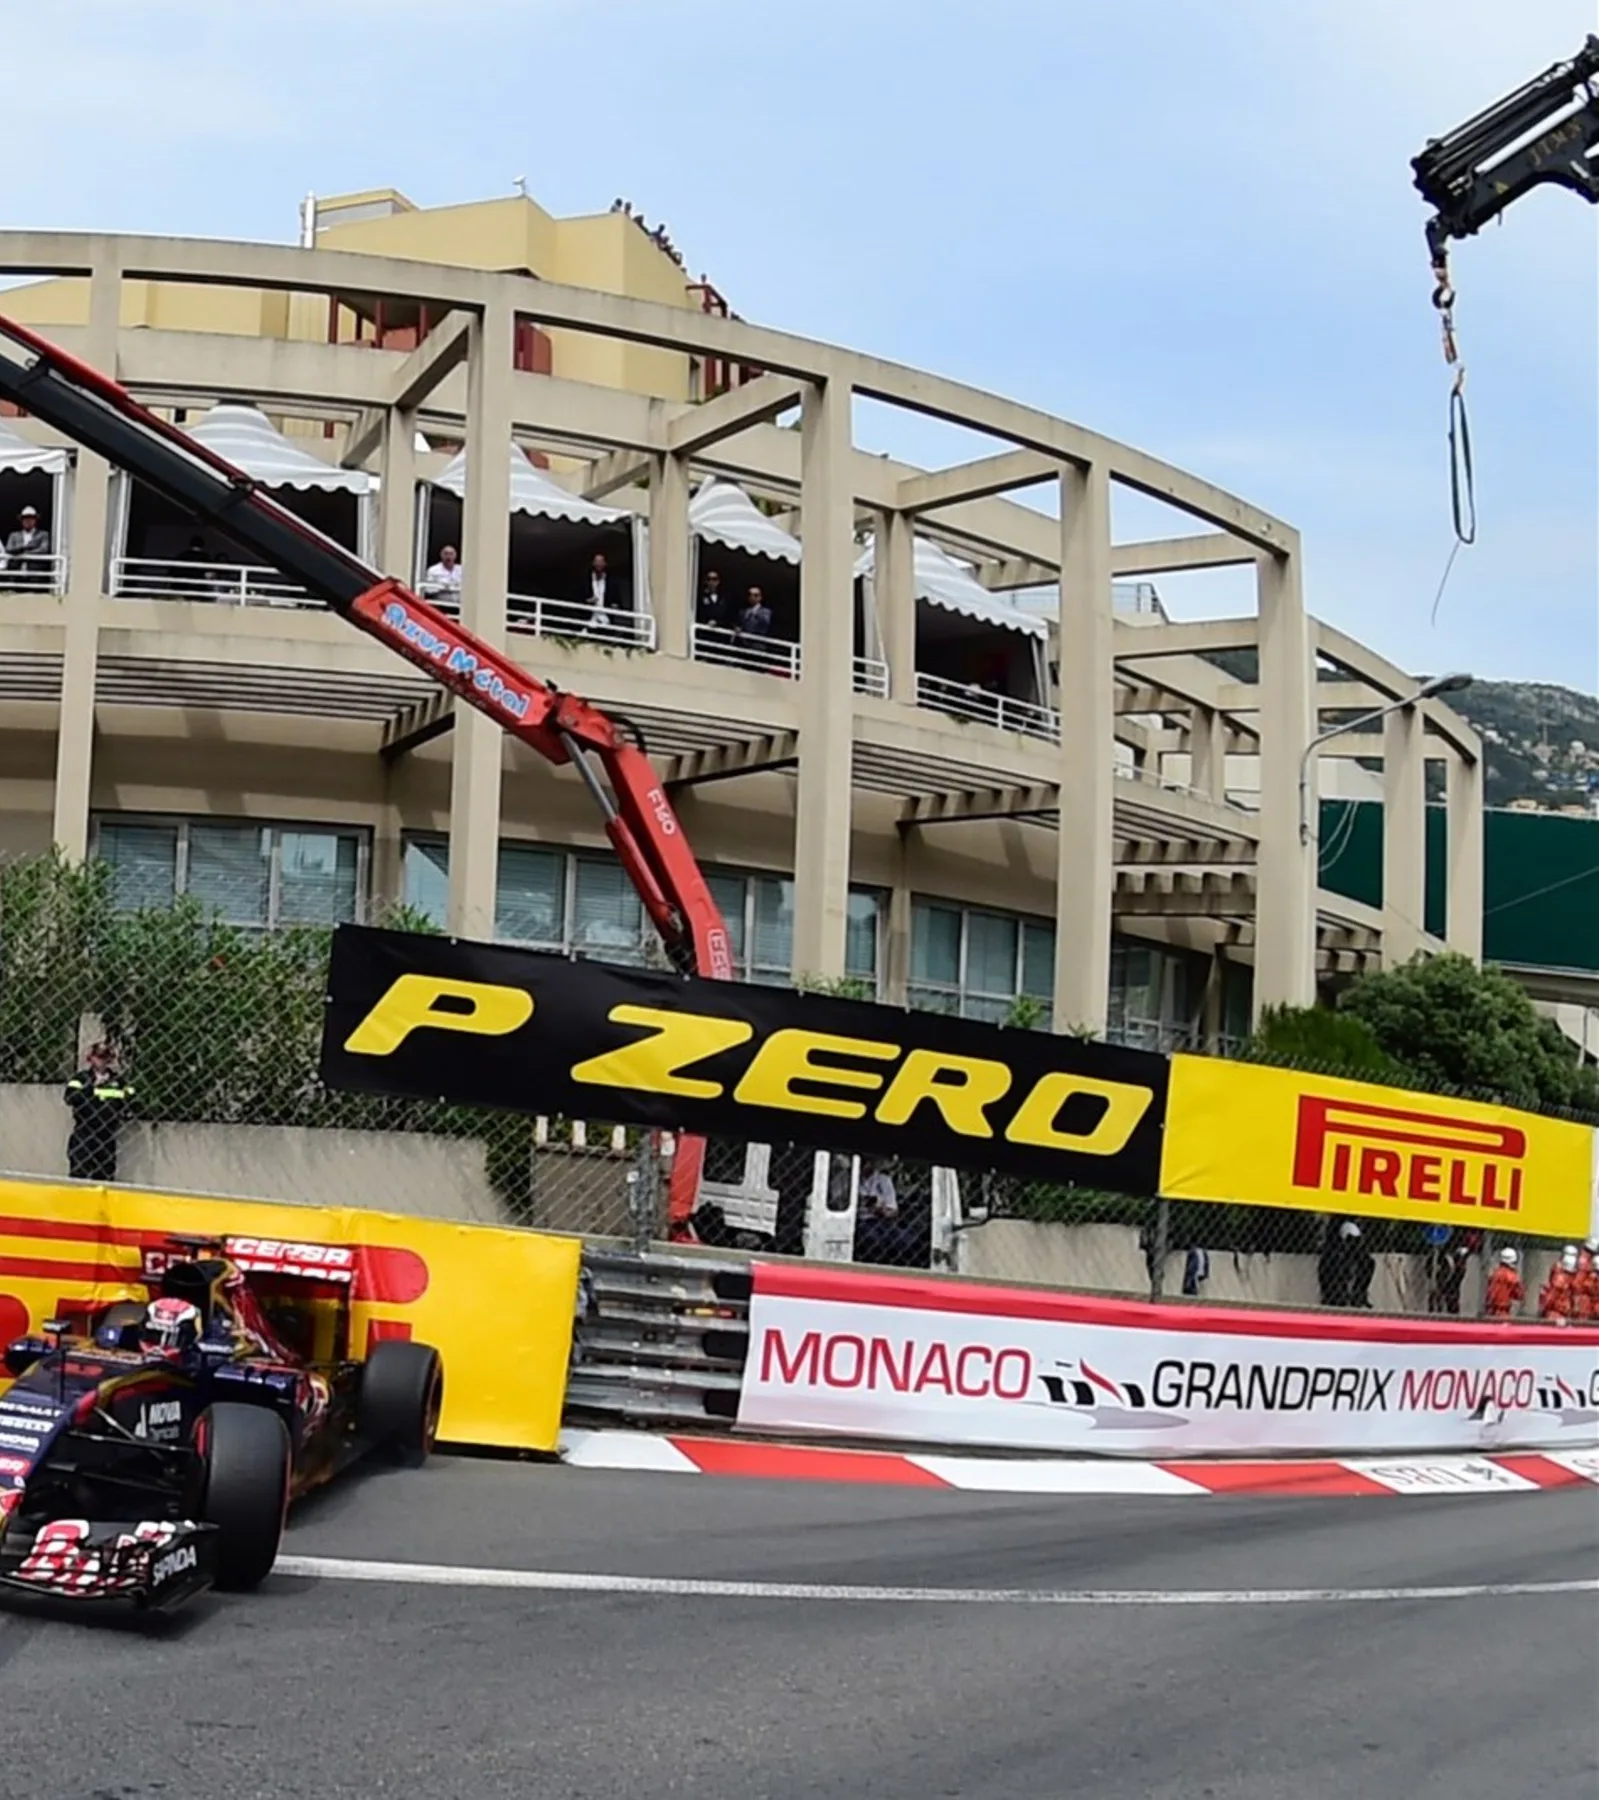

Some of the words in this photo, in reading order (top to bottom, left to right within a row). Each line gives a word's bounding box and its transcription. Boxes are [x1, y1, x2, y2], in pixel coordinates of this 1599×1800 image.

[381, 602, 450, 659] Azur
[343, 972, 534, 1055] P
[570, 1003, 1155, 1156] ZERO
[1292, 1094, 1527, 1212] PIRELLI
[233, 1237, 352, 1265] CEPSA
[760, 1328, 1032, 1400] MONACO
[1153, 1360, 1397, 1411] GRANDPRIX
[1399, 1368, 1535, 1411] MONACO
